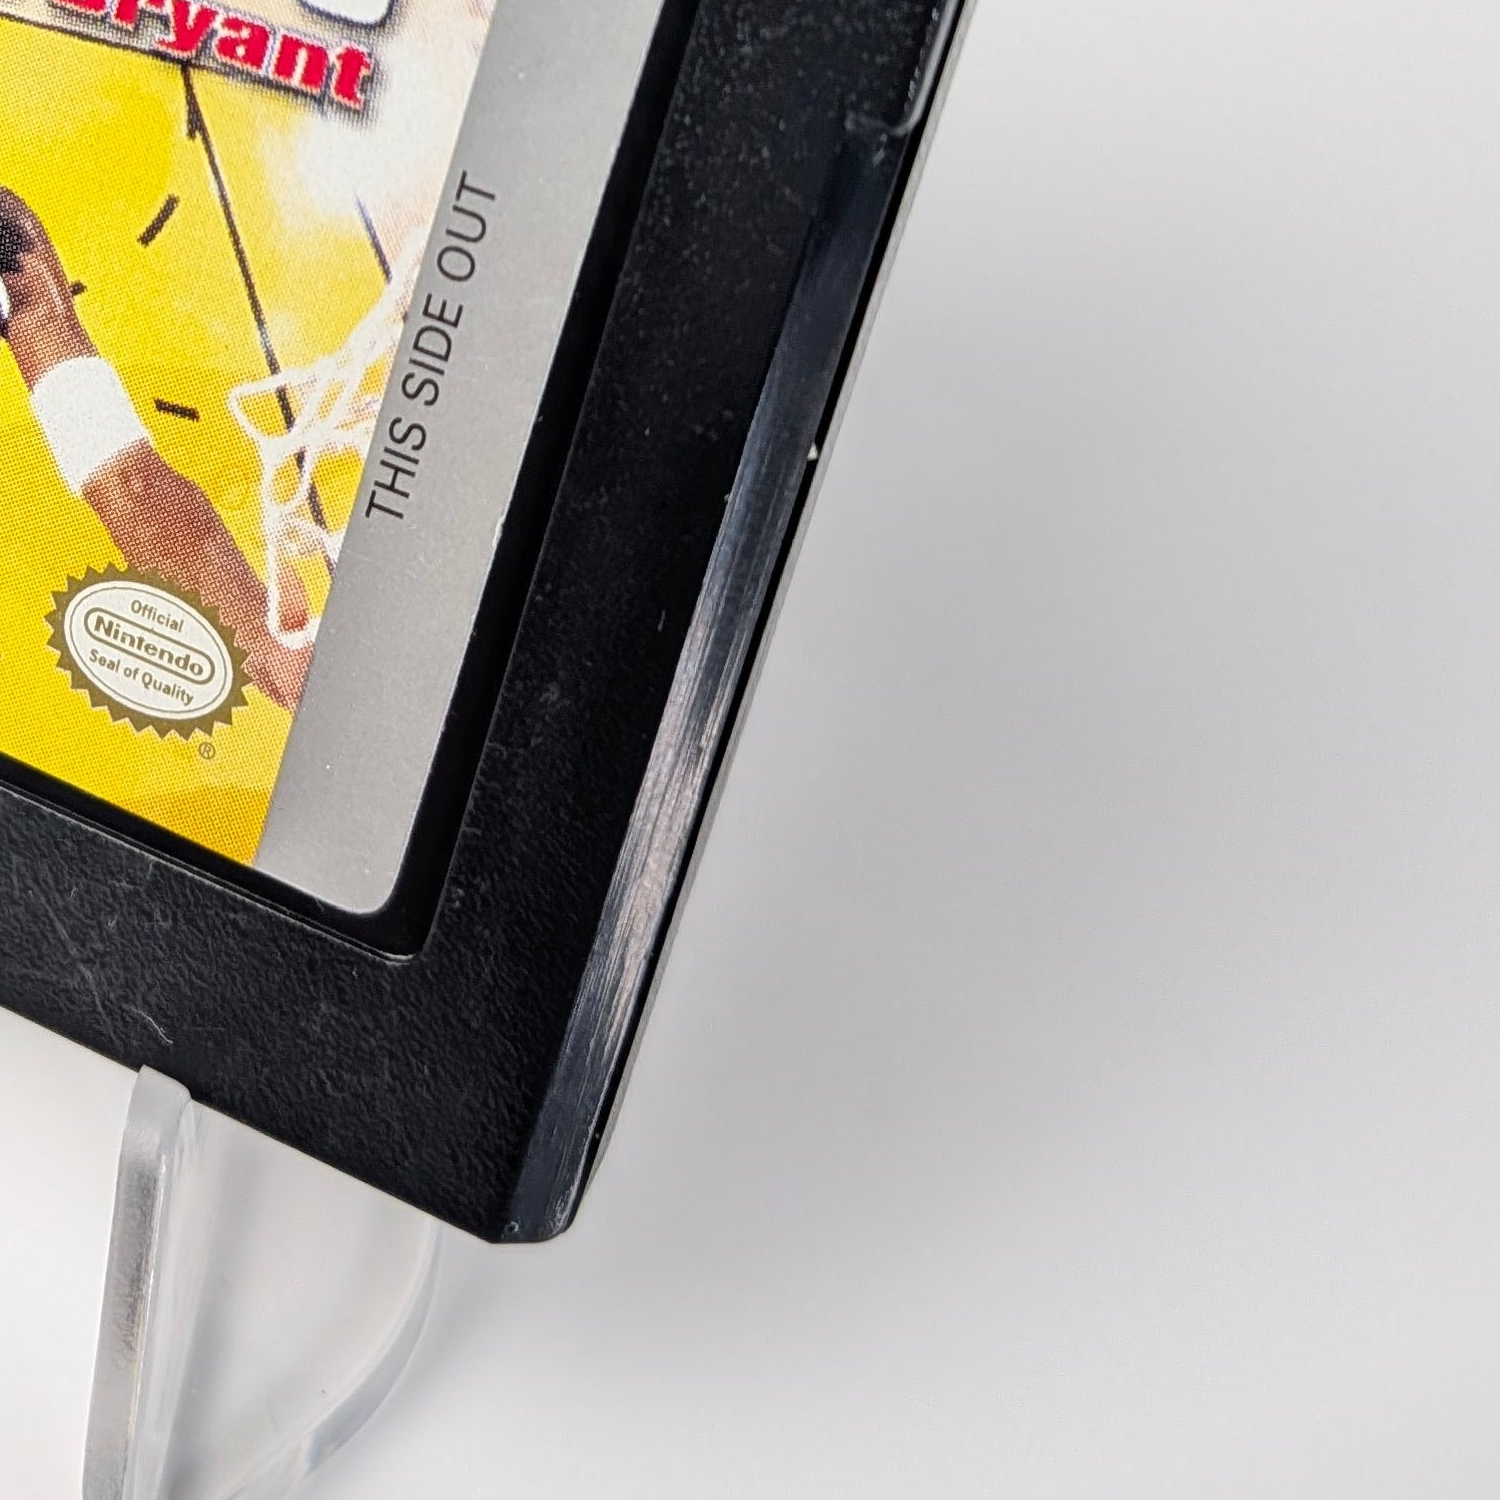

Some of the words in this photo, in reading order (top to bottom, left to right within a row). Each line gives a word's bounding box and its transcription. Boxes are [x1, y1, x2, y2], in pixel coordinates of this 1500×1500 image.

[365, 417, 427, 519] THIS
[401, 292, 463, 407] SIDE
[437, 170, 496, 282] OUT
[94, 615, 203, 676] Nintendo
[131, 599, 184, 633] Official
[89, 648, 120, 673] Seal
[123, 665, 139, 680] of
[141, 671, 193, 706] Quality
